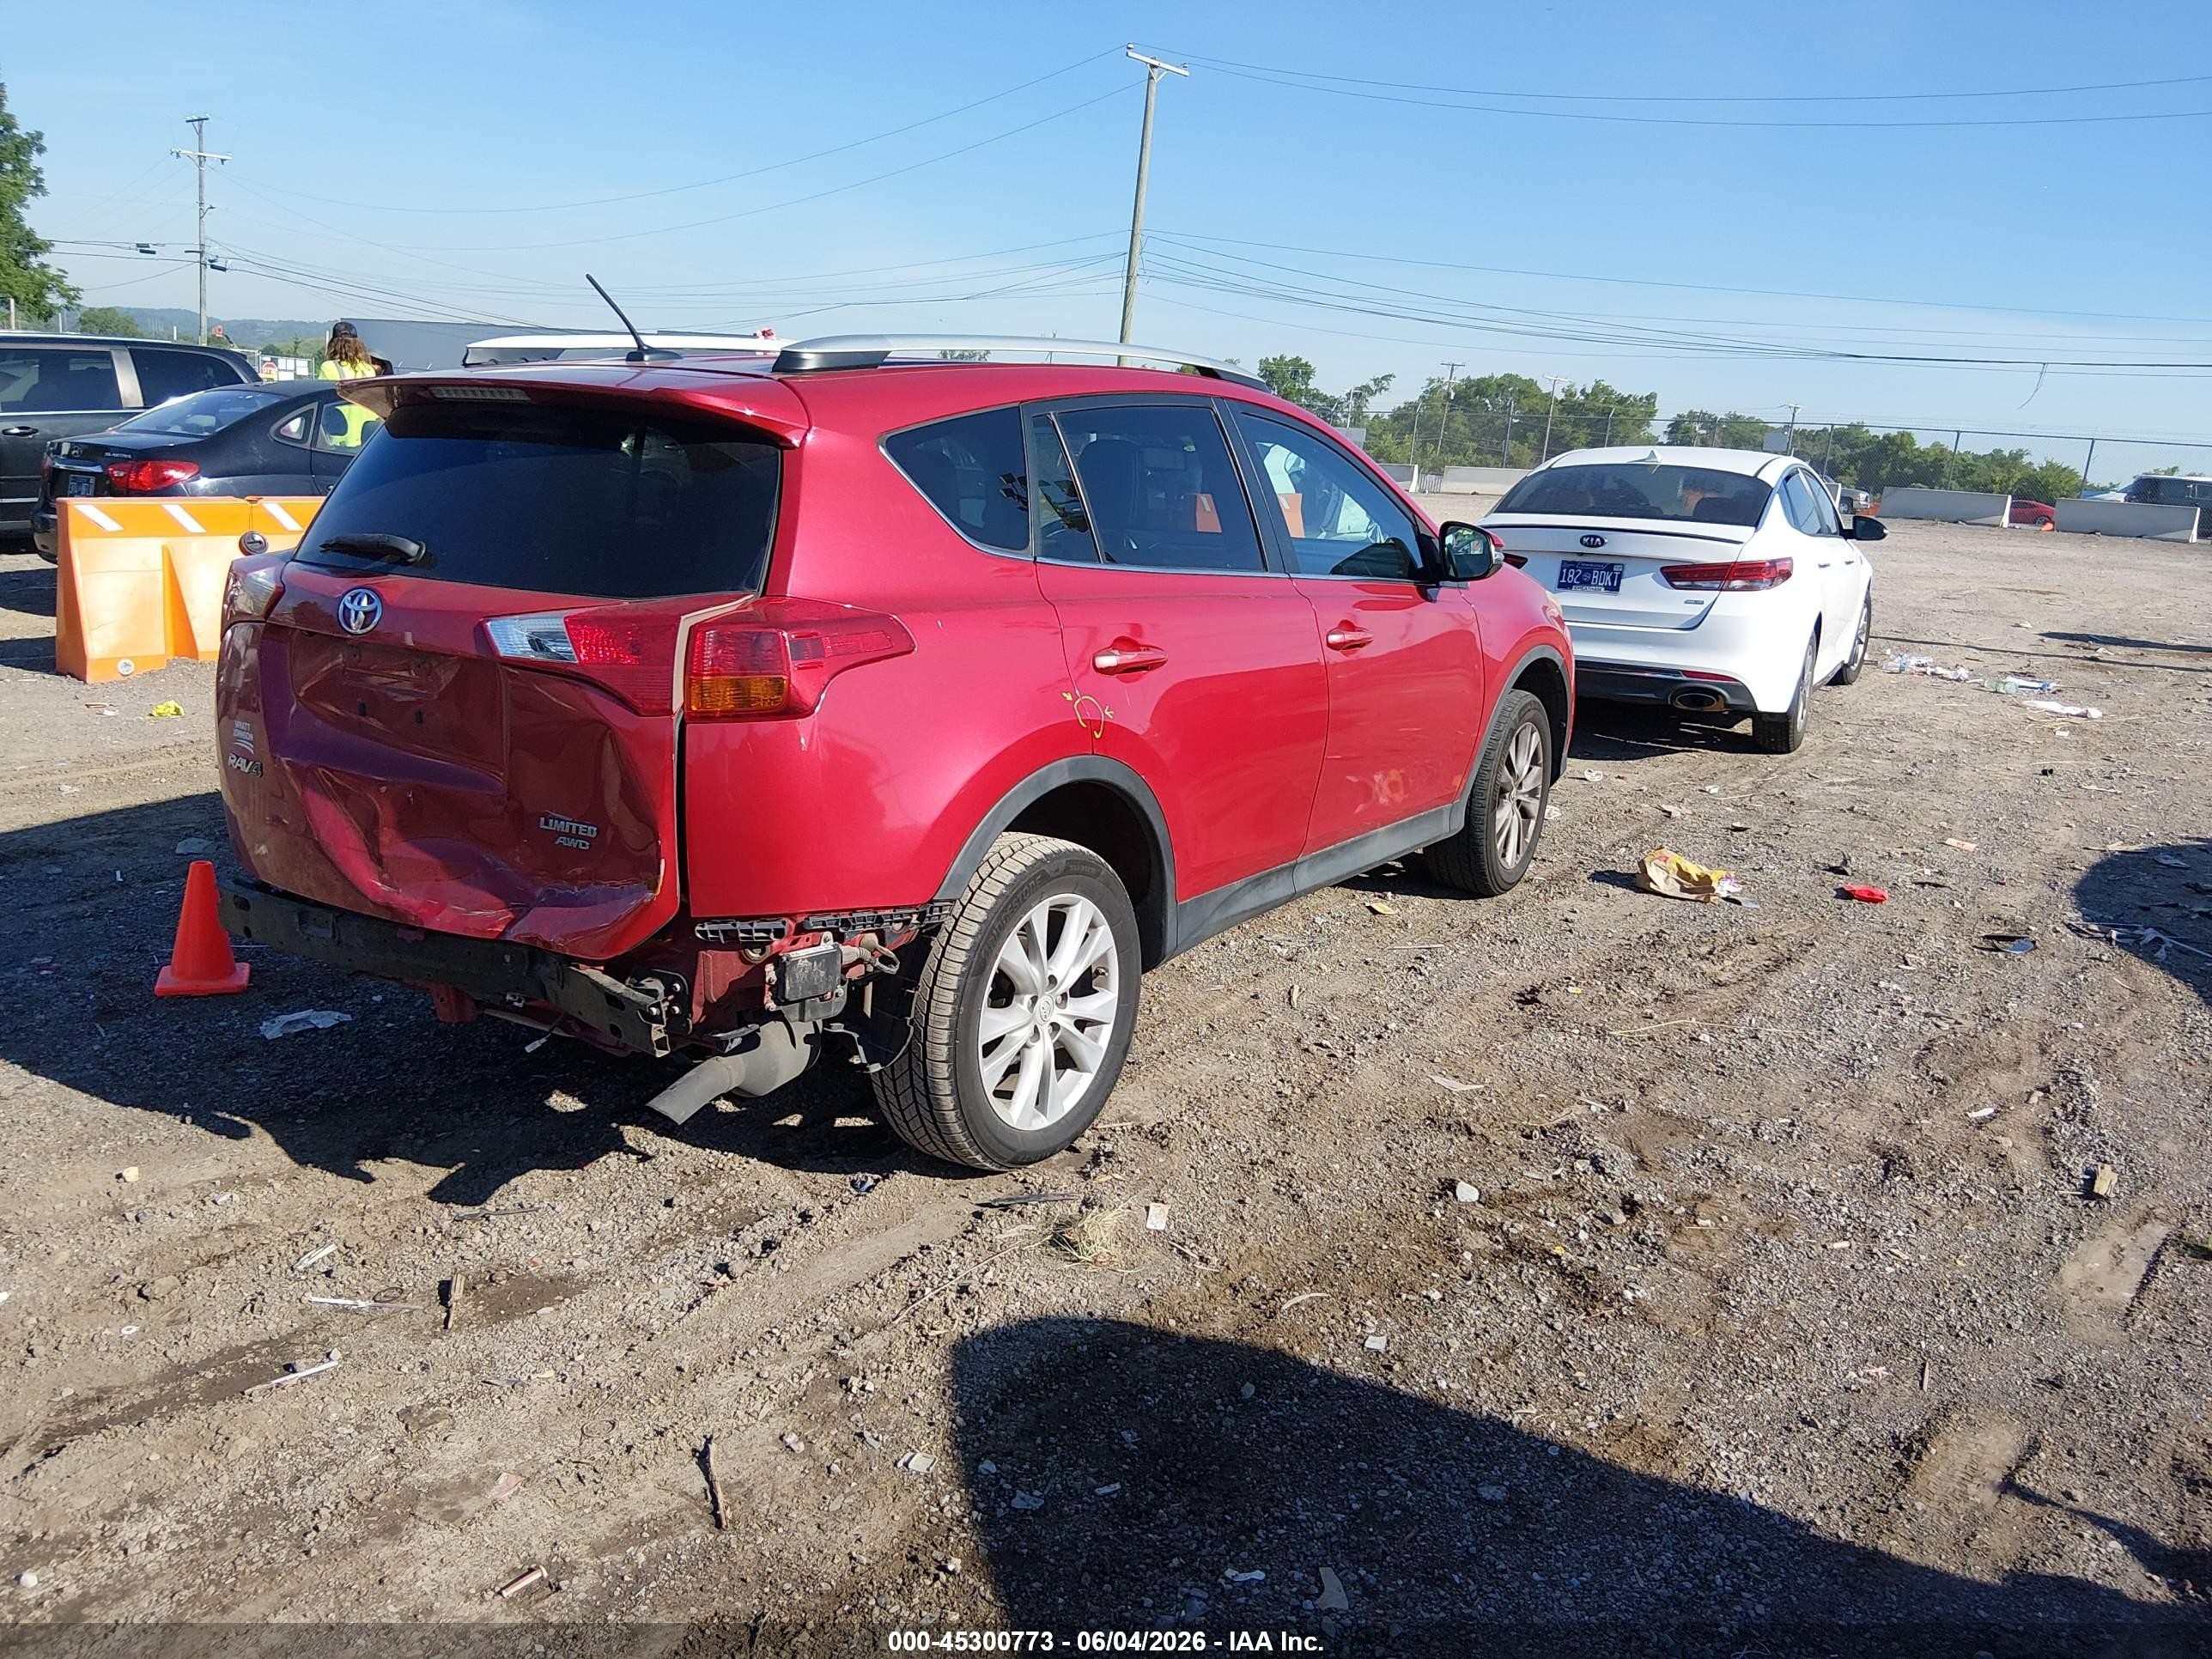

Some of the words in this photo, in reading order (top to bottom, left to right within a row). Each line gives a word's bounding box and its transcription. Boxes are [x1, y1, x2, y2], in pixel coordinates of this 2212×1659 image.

[1583, 537, 1601, 546] KIA
[1559, 568, 1583, 584] 182
[1591, 570, 1621, 586] BDKT
[228, 753, 263, 778] RAV4
[539, 817, 598, 838] LIMITED
[555, 836, 590, 850] AWD
